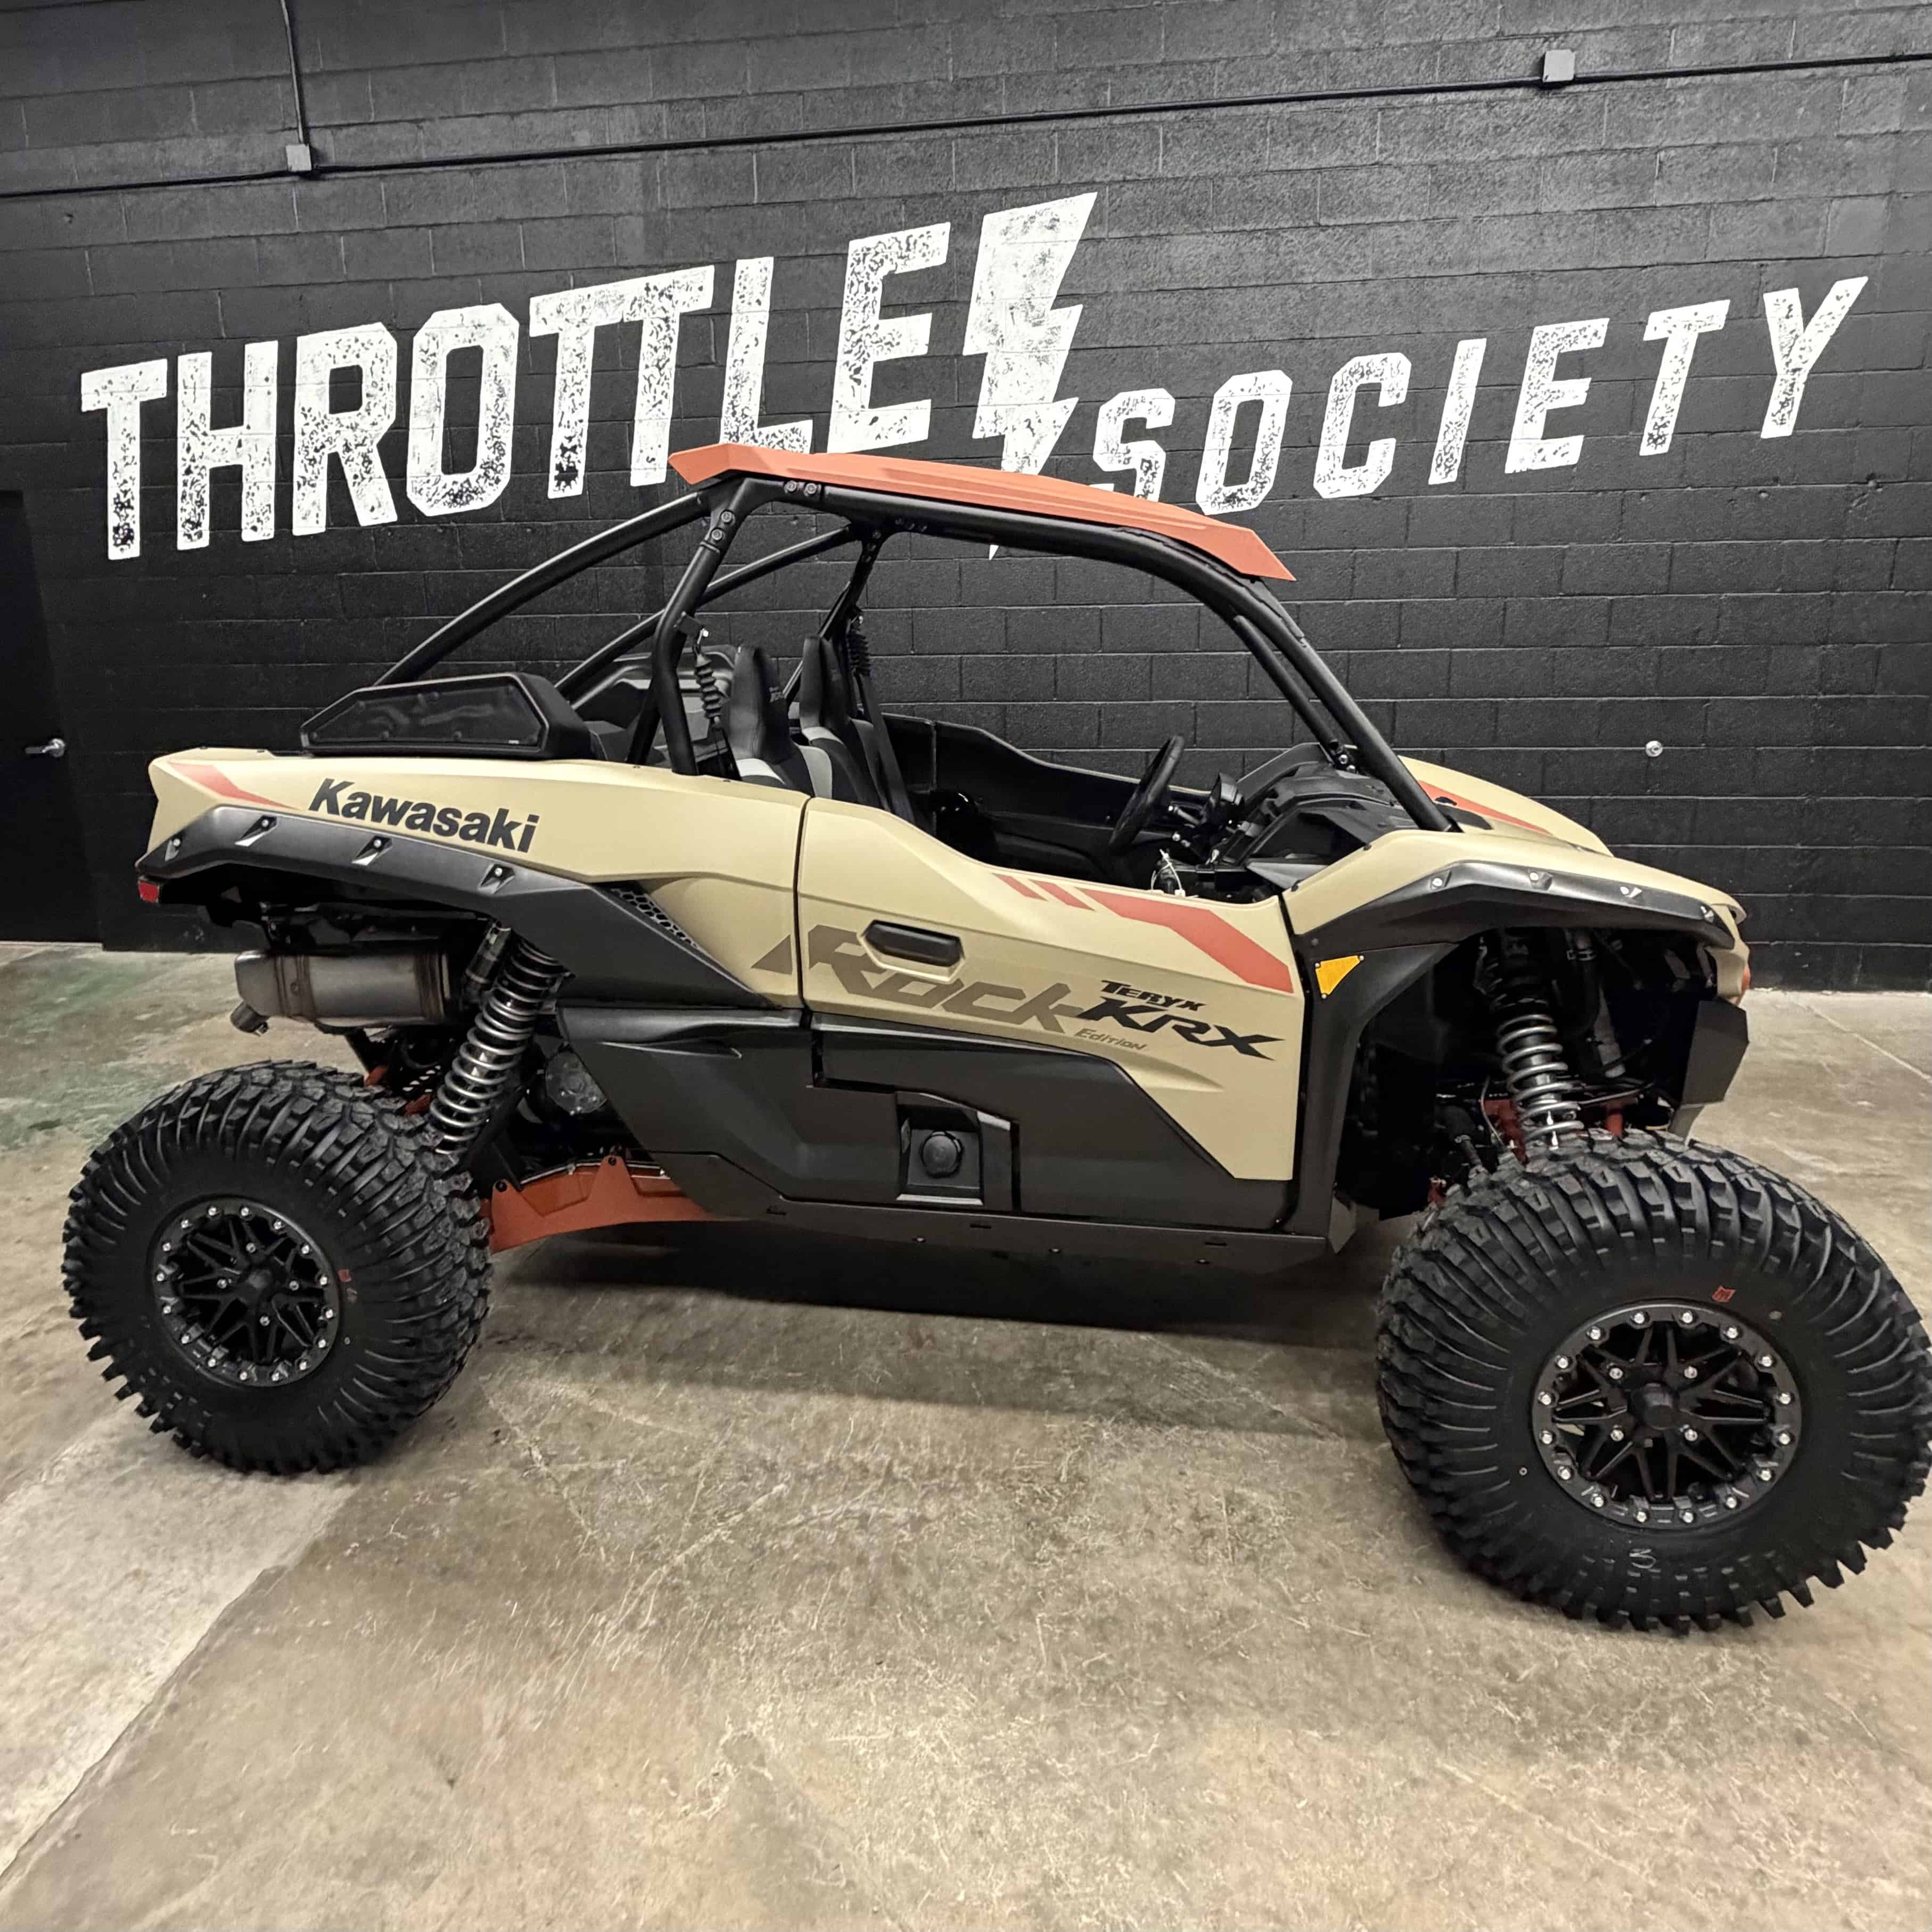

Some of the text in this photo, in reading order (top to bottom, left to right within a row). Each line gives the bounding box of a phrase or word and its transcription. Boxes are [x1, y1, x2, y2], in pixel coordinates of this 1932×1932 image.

[81, 222, 1869, 560] THROTTLE SOCIETY
[308, 778, 540, 853] Kawasaki
[1077, 997, 1285, 1060] KRX
